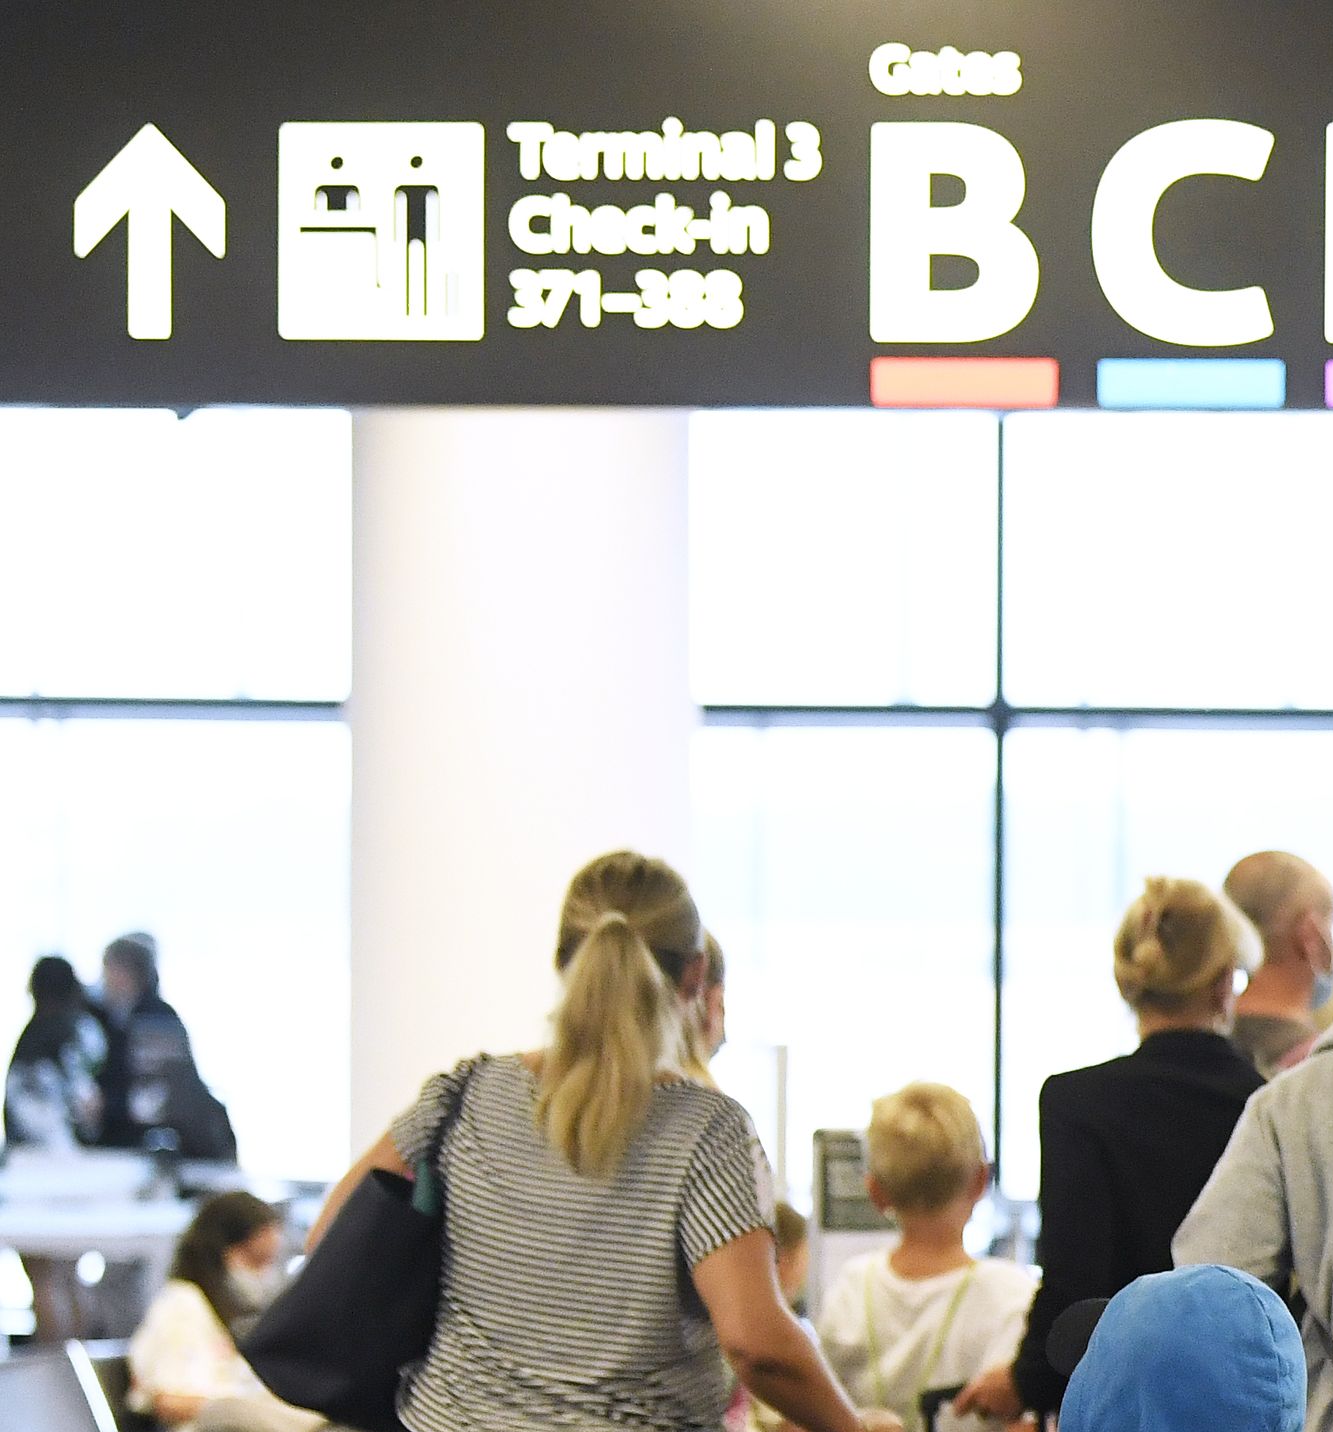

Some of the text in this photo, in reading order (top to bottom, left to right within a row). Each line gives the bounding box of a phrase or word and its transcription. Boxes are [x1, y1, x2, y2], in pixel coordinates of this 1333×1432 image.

[868, 42, 1024, 97] Gates
[505, 115, 824, 182] Terminal 3
[507, 189, 771, 256] Check-in
